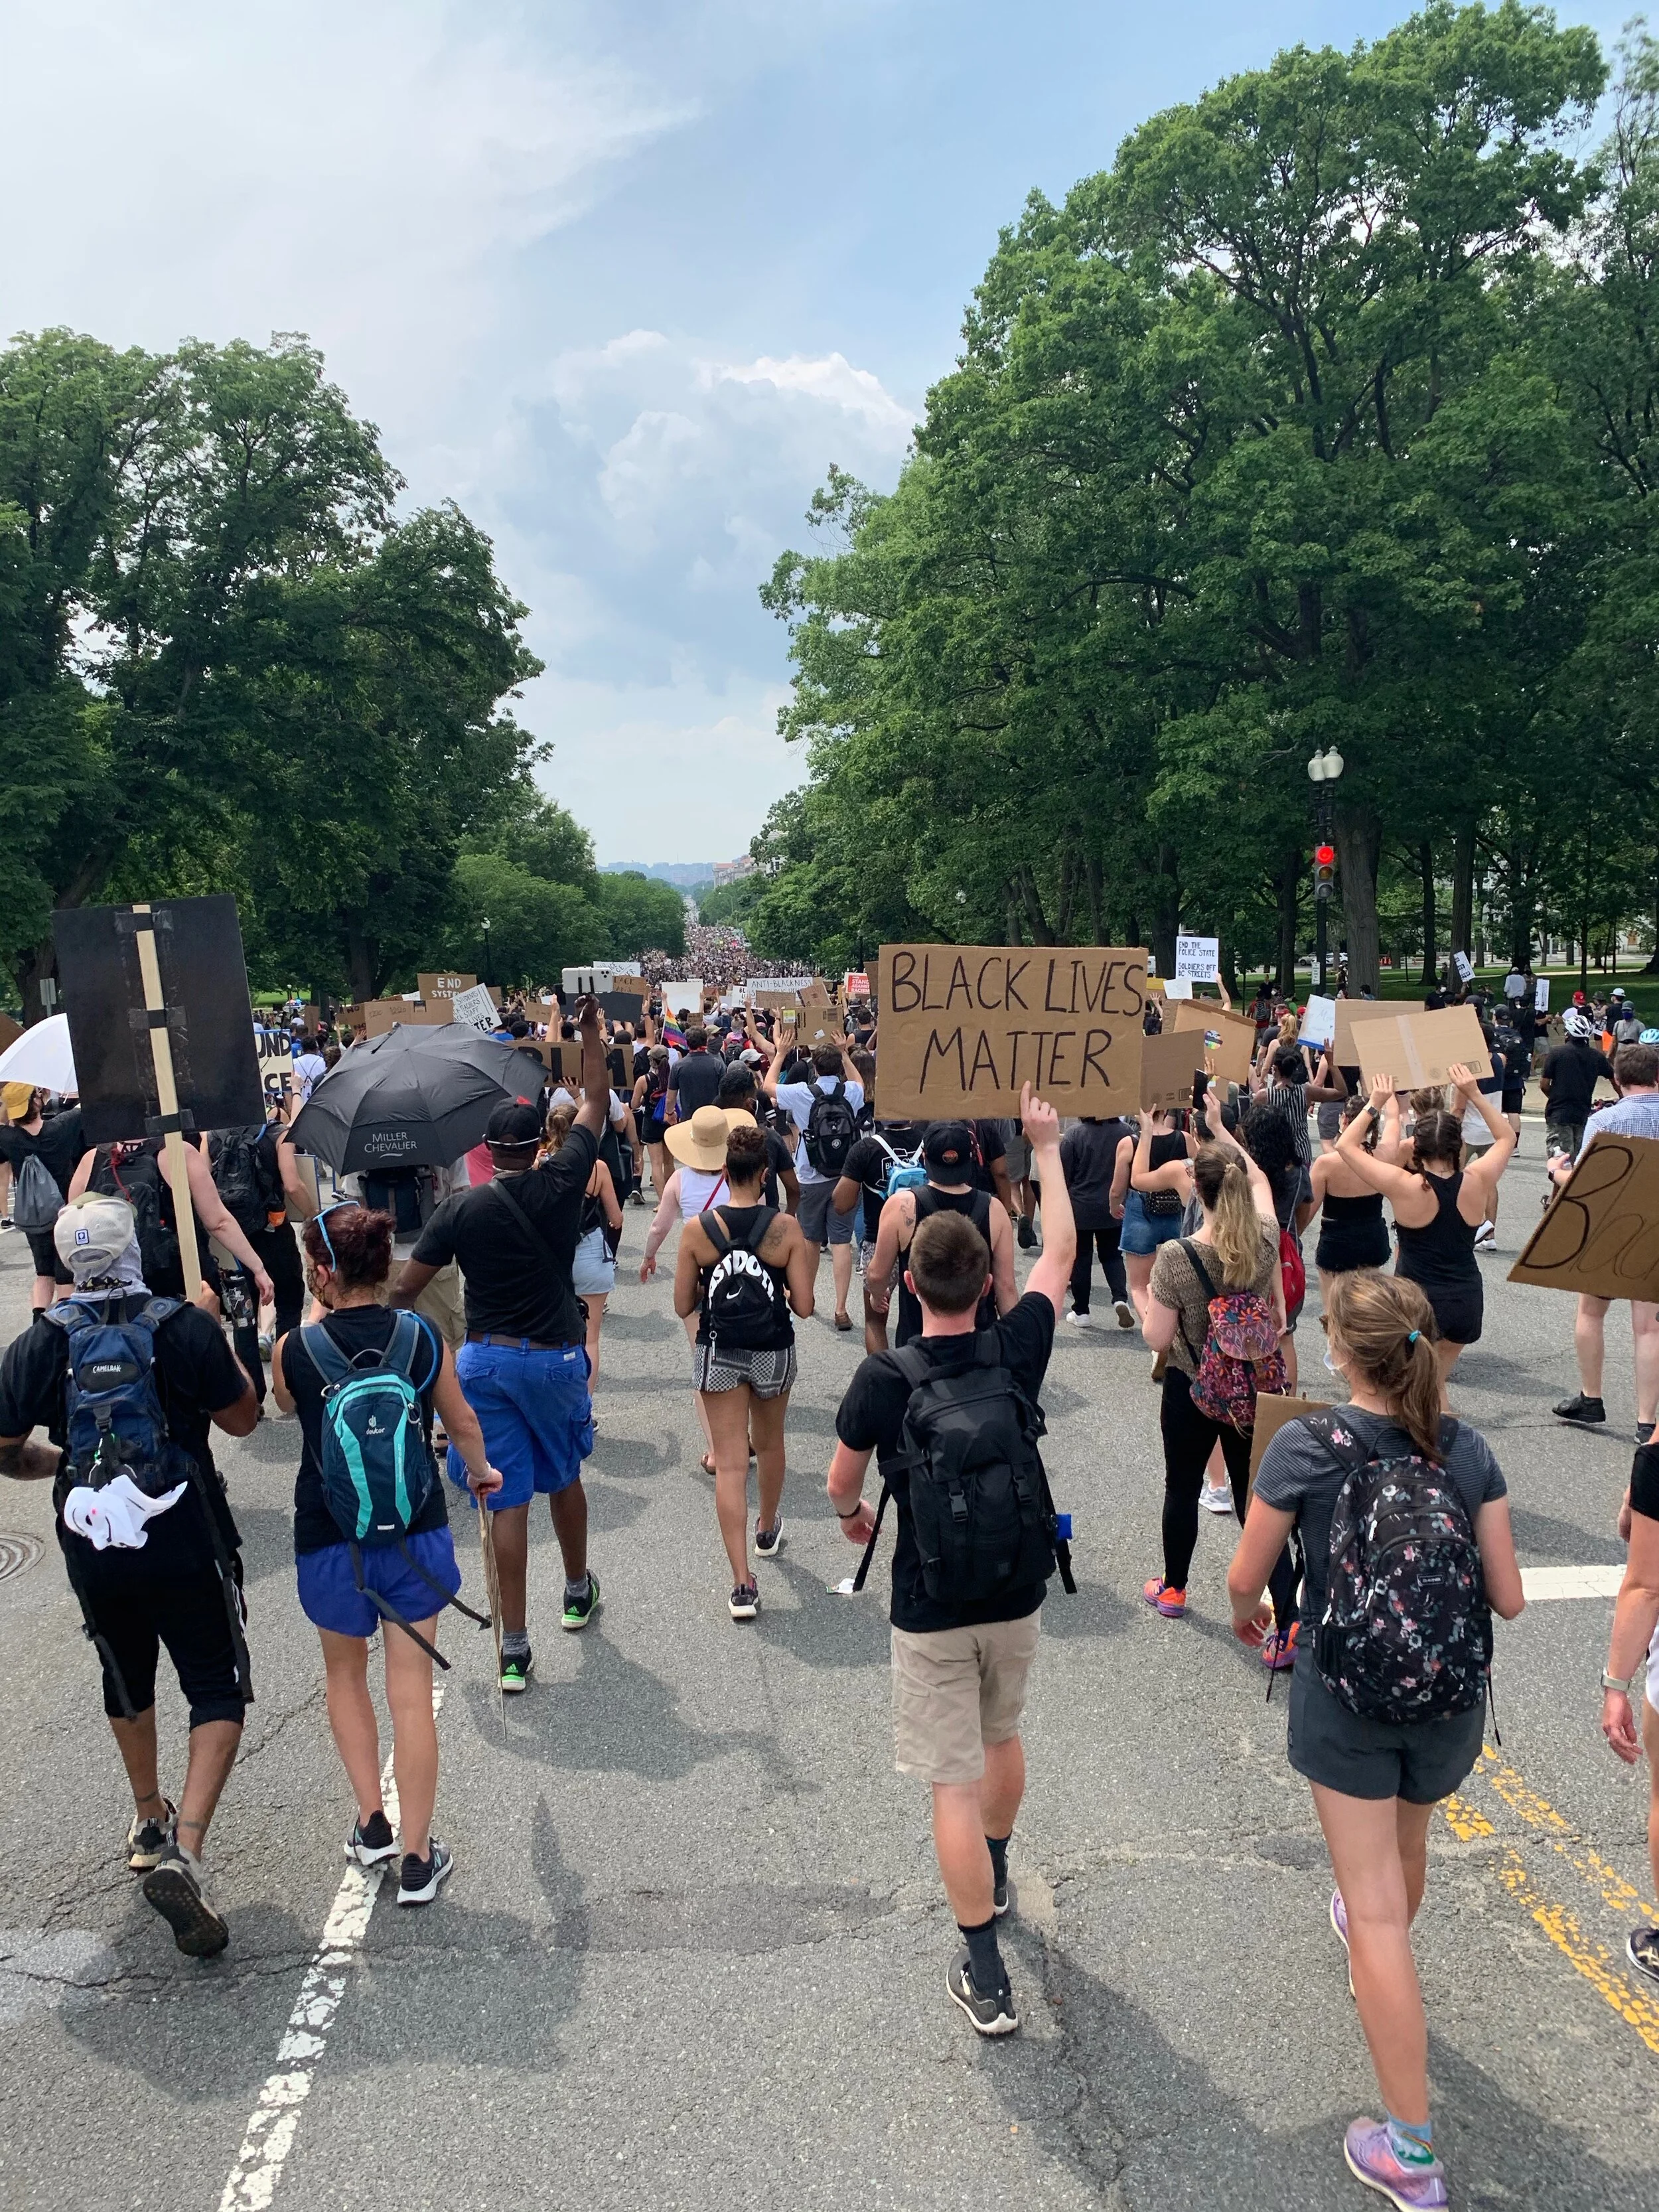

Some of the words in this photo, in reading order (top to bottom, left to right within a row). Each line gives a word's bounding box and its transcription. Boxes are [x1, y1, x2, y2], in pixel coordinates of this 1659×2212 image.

[437, 977, 462, 989] END
[892, 951, 1030, 1013] BLACK
[1045, 958, 1143, 1017] LIVES
[431, 990, 459, 998] SYSTE
[464, 1006, 478, 1018] STAFF
[920, 1027, 1112, 1093] MATTER
[372, 1132, 408, 1142] MILLER
[364, 1141, 417, 1153] CHEVALIER
[732, 1250, 762, 1277] DO
[92, 1364, 122, 1374] CAMELBAK
